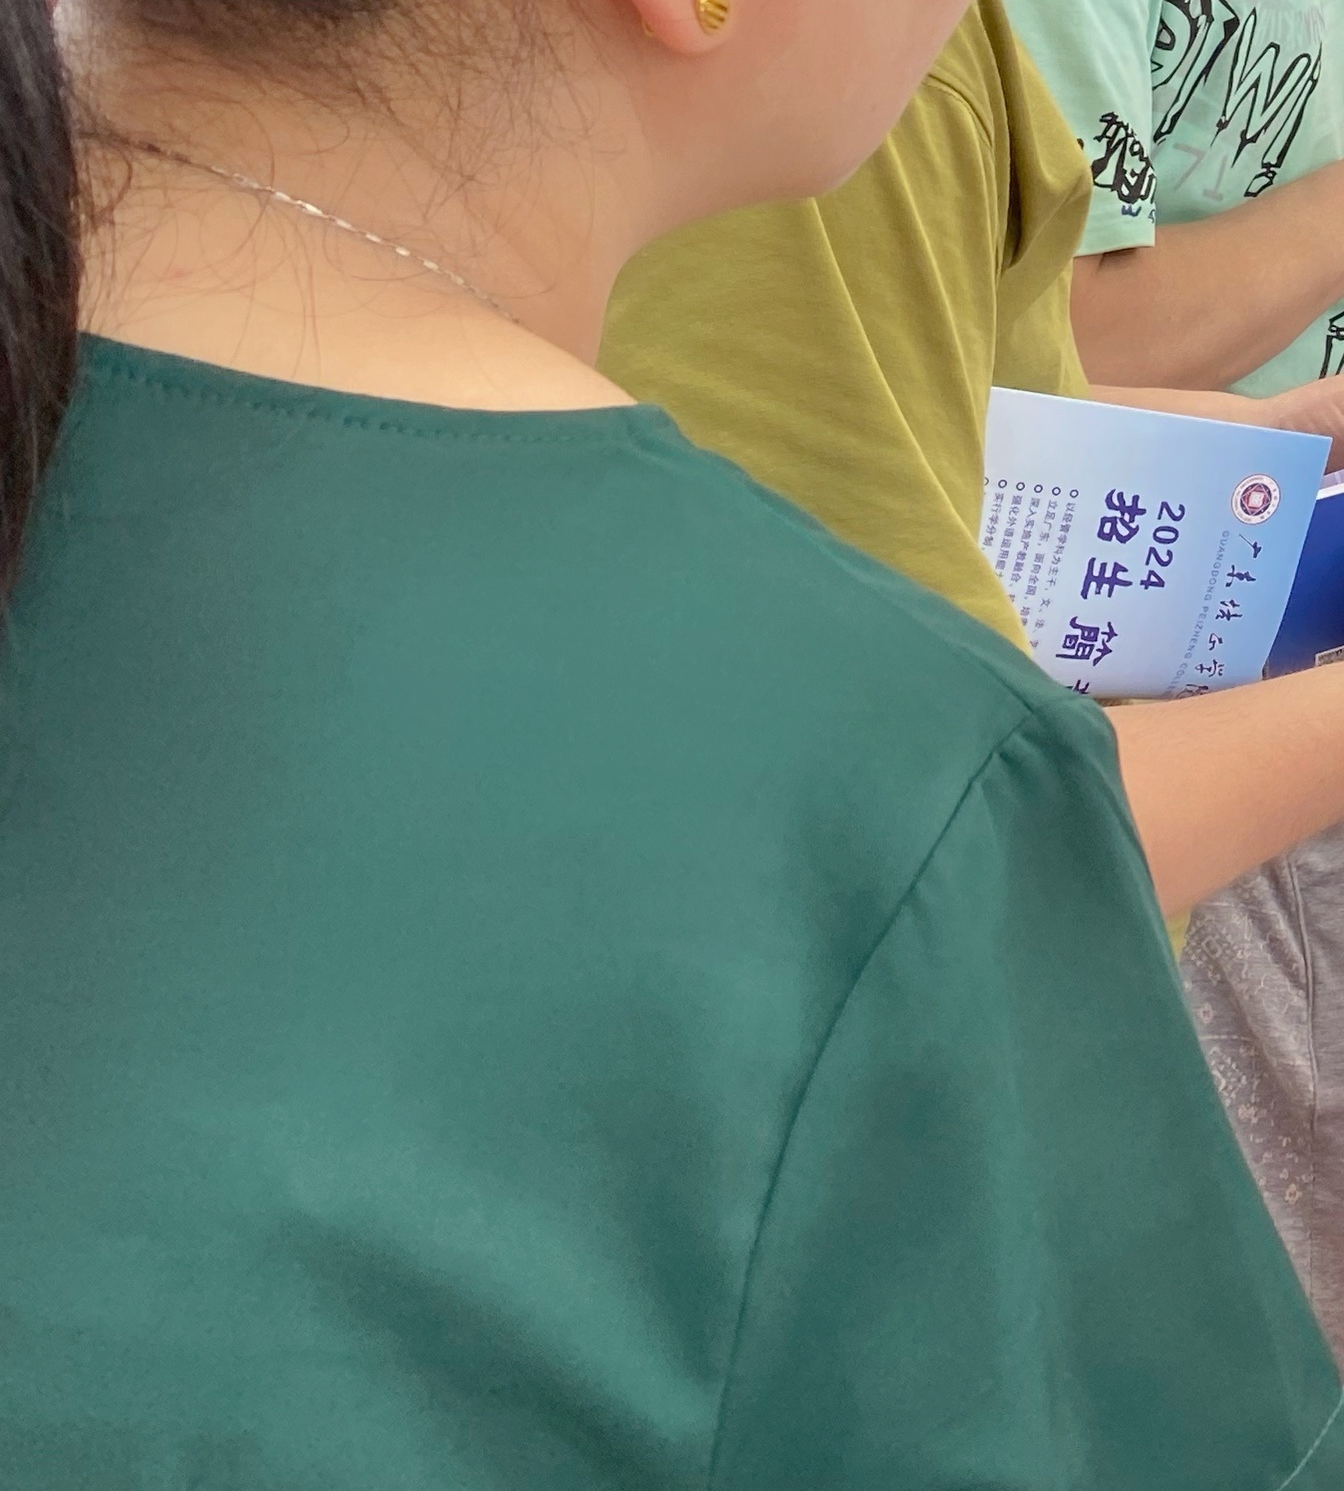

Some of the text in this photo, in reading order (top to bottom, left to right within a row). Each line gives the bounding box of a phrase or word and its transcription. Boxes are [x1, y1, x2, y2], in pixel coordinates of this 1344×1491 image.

[1140, 501, 1186, 590] 2024
[1204, 530, 1230, 601] GUANGDONG
[1184, 605, 1210, 661] PEIZHENG
